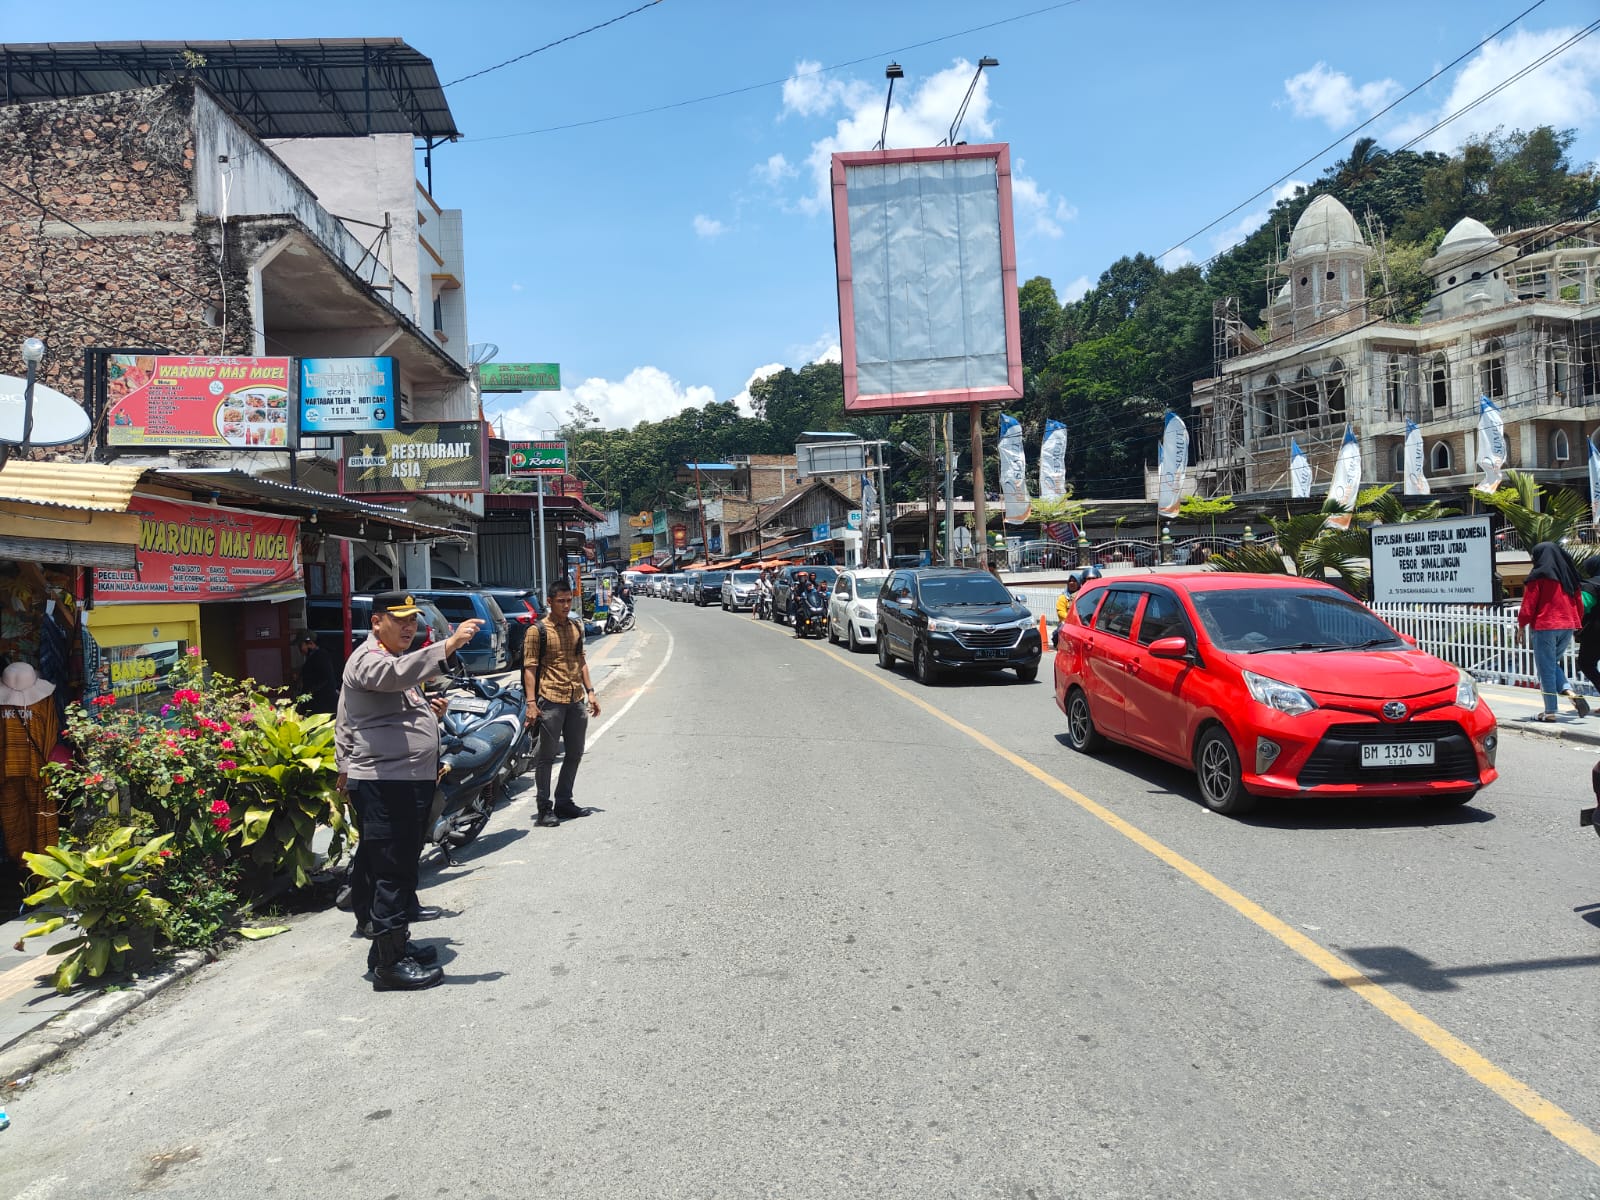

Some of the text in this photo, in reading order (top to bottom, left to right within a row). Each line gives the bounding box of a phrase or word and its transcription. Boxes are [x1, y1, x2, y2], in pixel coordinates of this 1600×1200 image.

[159, 365, 286, 379] WARUNG MAS MOEL
[391, 442, 471, 459] RESTAURANT
[350, 457, 385, 466] BINTANG
[529, 457, 563, 465] Resto
[391, 462, 420, 477] ASIA
[139, 519, 215, 556] WARUNG
[219, 529, 251, 559] MAS
[253, 531, 289, 561] MOEL
[1374, 526, 1487, 545] KEPOLISIAN NEGARA REPUBLIK INDONESIA
[1392, 542, 1467, 557] DAERAH SUMATERA UTARA
[173, 565, 187, 573] NASI
[209, 566, 225, 574] BAKSO
[1399, 557, 1460, 570] RESOR SIMALUNGUN
[98, 571, 135, 581] PECEL LELE
[1402, 571, 1458, 583] SEKTOR PARAPAT
[98, 583, 168, 592] IKAN NILA ASAM MANIS
[111, 658, 156, 683] BAKSO
[112, 680, 158, 698] MAS MOEL
[1364, 744, 1432, 759] BM 1316 SV
